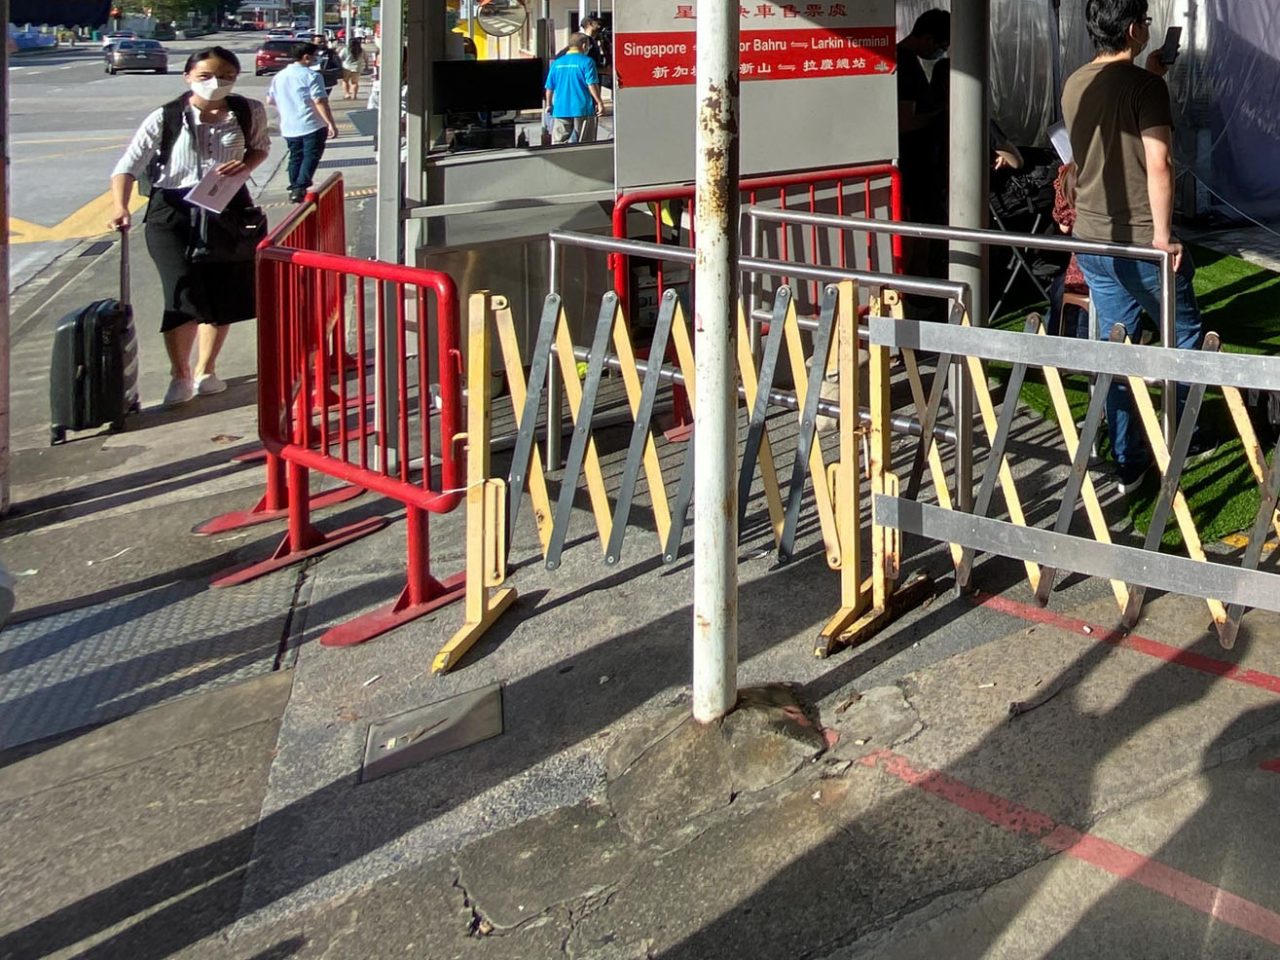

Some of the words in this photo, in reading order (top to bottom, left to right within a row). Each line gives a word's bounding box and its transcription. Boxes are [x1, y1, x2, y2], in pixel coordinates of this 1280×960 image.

[623, 42, 687, 58] Singapore
[753, 39, 787, 52] Bahru
[811, 36, 844, 49] Larkin
[846, 35, 889, 49] Terminal
